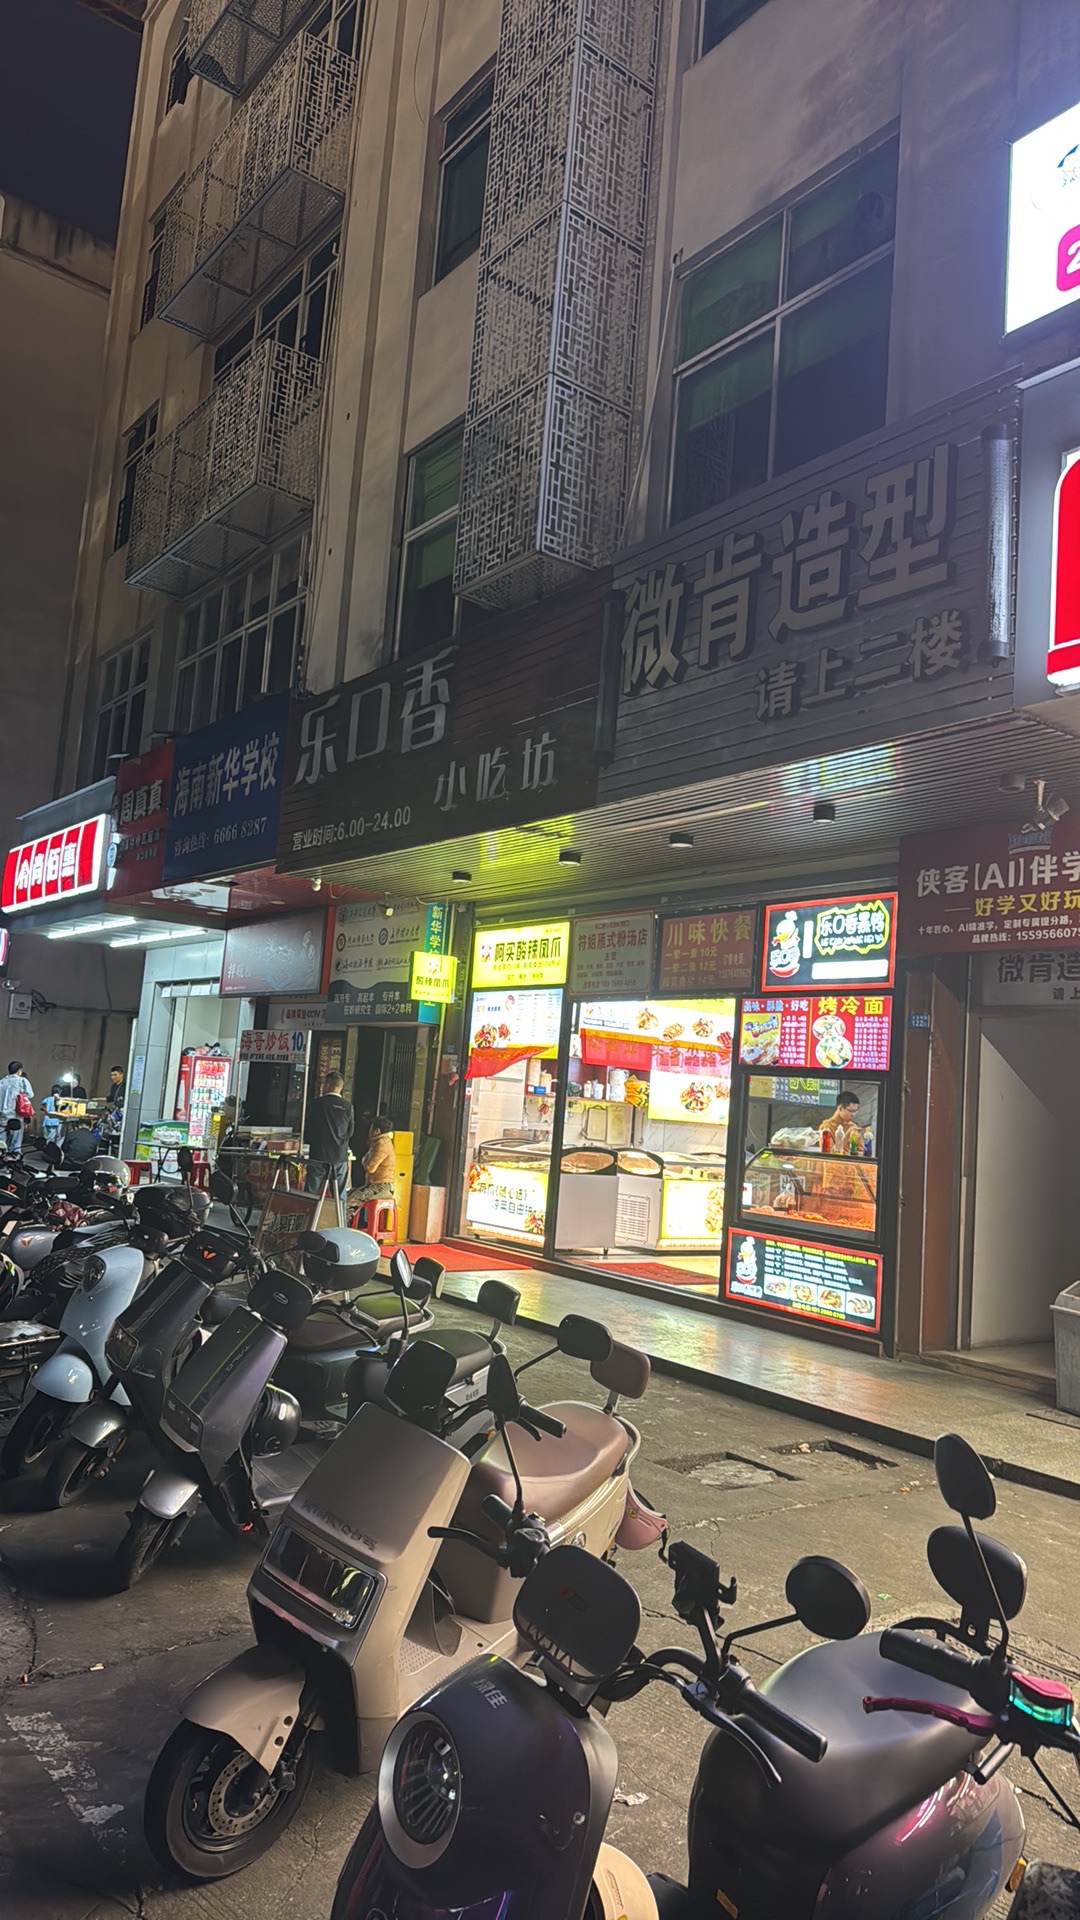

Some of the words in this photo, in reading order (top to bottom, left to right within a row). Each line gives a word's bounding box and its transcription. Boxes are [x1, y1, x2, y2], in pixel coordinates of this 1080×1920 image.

[621, 443, 956, 692] 微肯造型
[755, 609, 963, 721] 请上二楼
[293, 646, 459, 786] 乐口香
[173, 731, 281, 818] 海南新华学校
[434, 731, 557, 812] 小吃坊
[213, 827, 238, 844] 6666
[241, 816, 268, 839] 8287
[428, 905, 443, 954] 新华学
[666, 914, 752, 947] 川味快餐
[699, 960, 717, 972] 12元
[700, 946, 718, 958] 10元
[382, 990, 400, 1002] 专升本
[818, 996, 885, 1016] 烤冷面
[239, 1030, 290, 1053] 海哥炒饭
